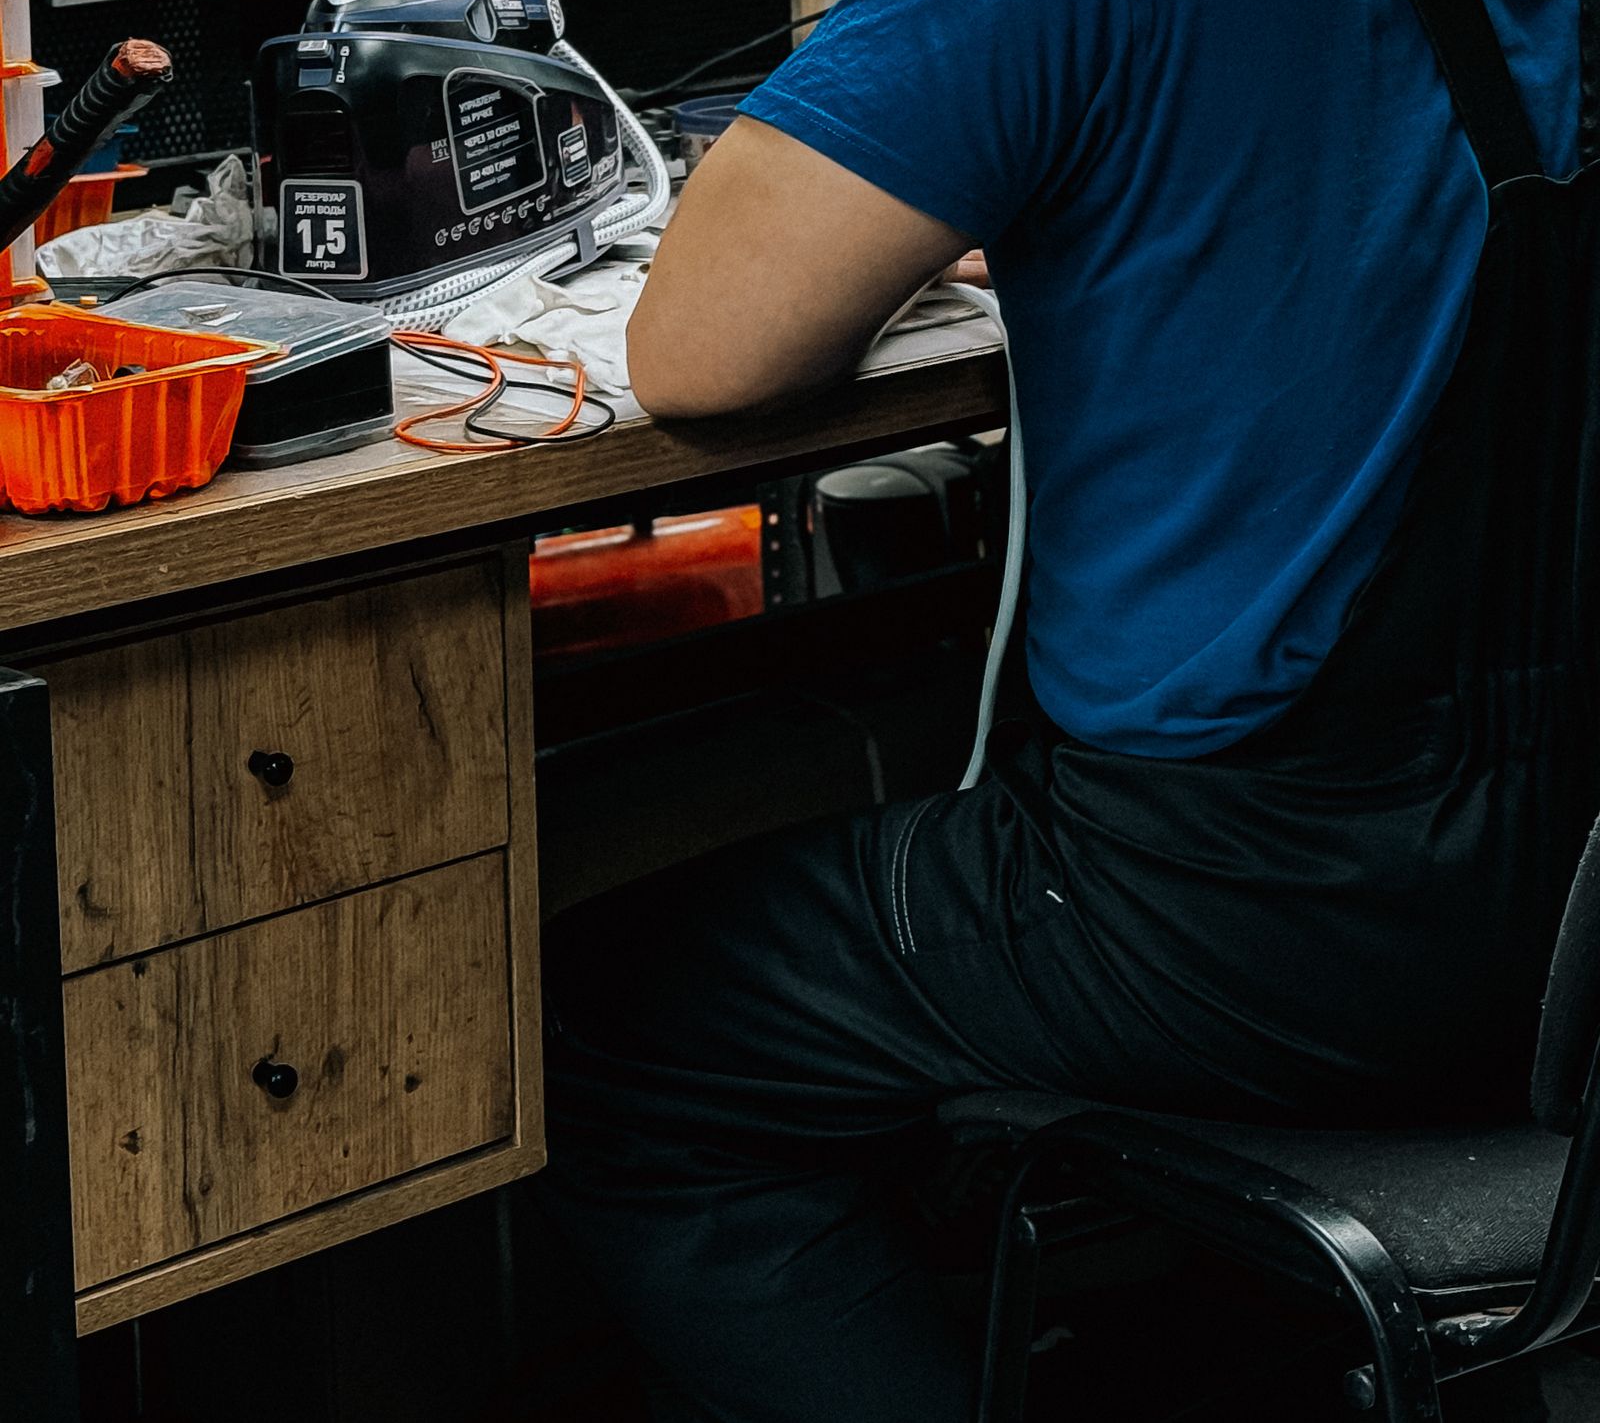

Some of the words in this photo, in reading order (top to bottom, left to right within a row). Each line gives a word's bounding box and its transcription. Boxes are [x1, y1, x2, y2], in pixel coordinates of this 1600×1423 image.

[431, 138, 448, 151] MAX
[464, 133, 486, 148] ЧЕРЕЗ
[295, 192, 346, 202] РЕЗЕРВУАР
[295, 205, 316, 215] ДЛЯ
[317, 205, 346, 215] ВОДЫ
[296, 218, 346, 259] 1,5
[305, 260, 336, 270] литра
